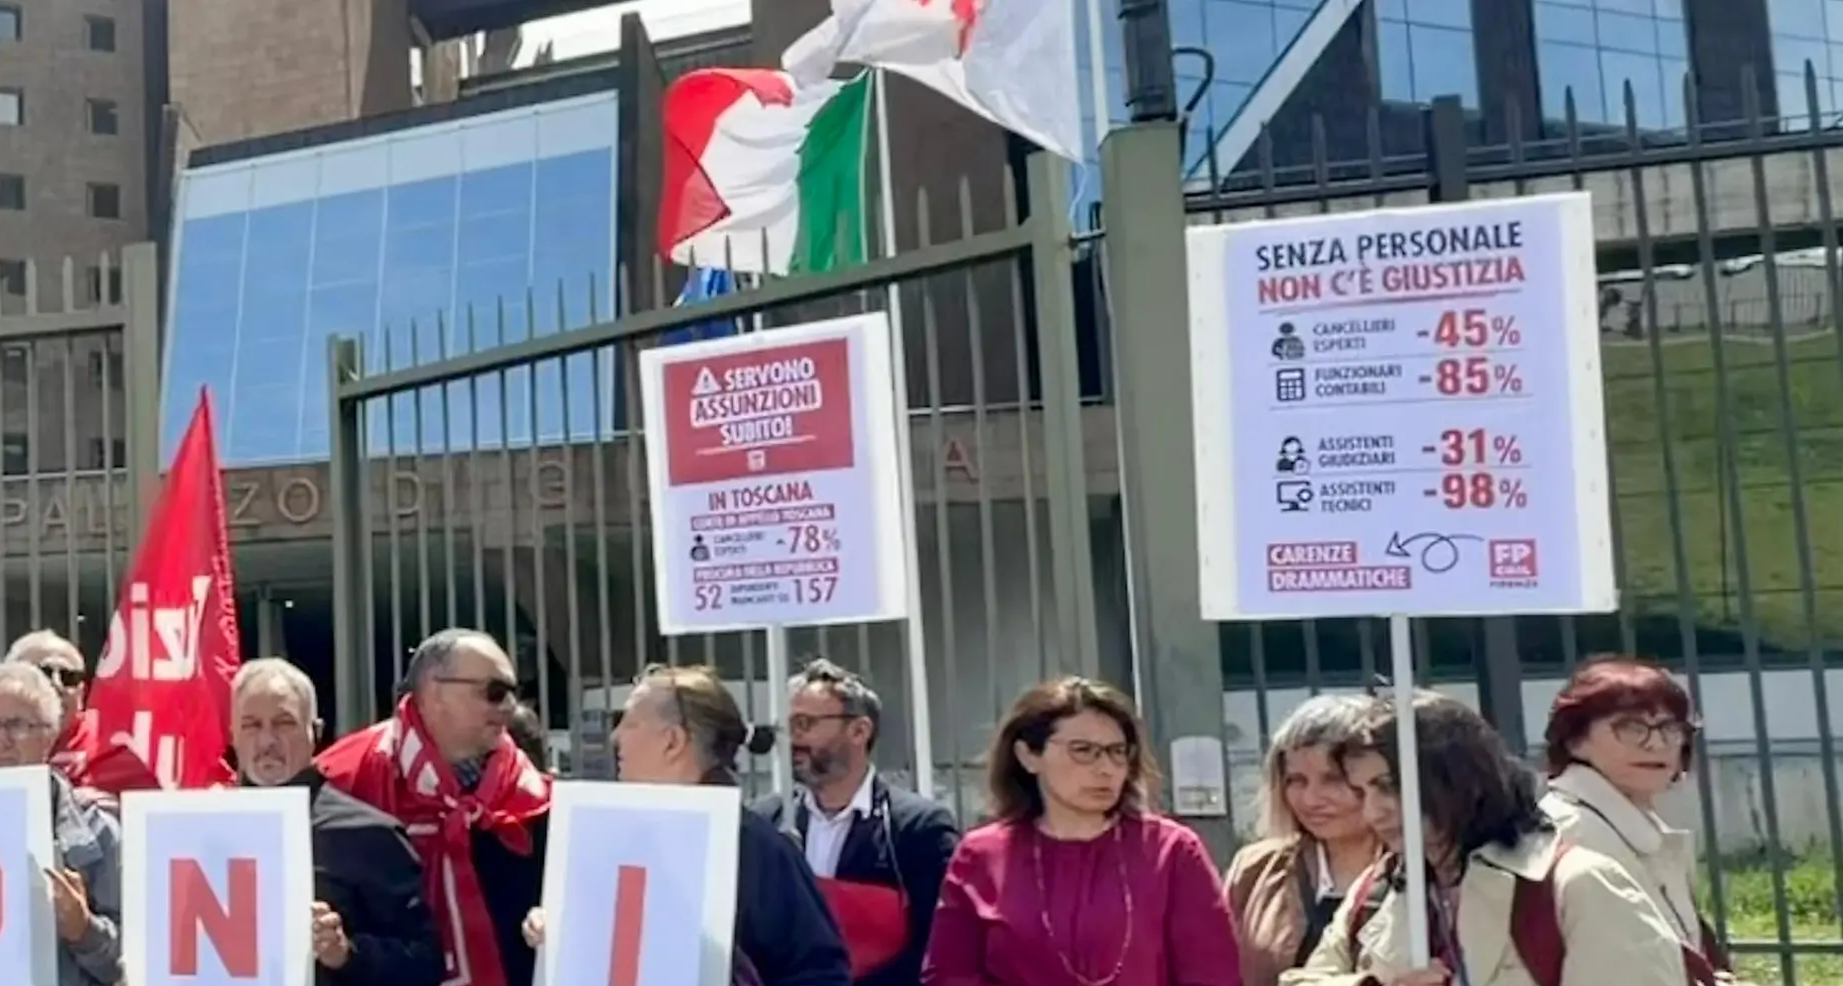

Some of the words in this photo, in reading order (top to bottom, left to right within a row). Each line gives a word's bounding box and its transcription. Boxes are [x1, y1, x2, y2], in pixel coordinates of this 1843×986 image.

[1256, 238, 1346, 272] SENZA
[1358, 221, 1523, 261] PERSONALE
[1258, 275, 1321, 304] NON
[1382, 256, 1526, 293] GIUSTIZIA
[1417, 308, 1521, 347] -45%
[724, 357, 814, 389] SERVONO
[1419, 357, 1522, 396] -85%
[695, 383, 817, 423] ASSUNZIONI
[720, 417, 792, 445] SUBITO!
[1318, 436, 1393, 451] ASSISTENTI
[1421, 428, 1522, 466] -31%
[708, 492, 727, 511] IN
[730, 481, 813, 507] TOSCANA
[1320, 481, 1396, 496] ASSISTENTI
[1423, 472, 1528, 509] -98%
[1270, 544, 1353, 566] CARENZE
[1494, 543, 1531, 563] FP
[696, 584, 722, 611] 52
[794, 577, 838, 604] 157
[1271, 566, 1408, 592] DRAMMATICHE
[169, 858, 258, 979] N
